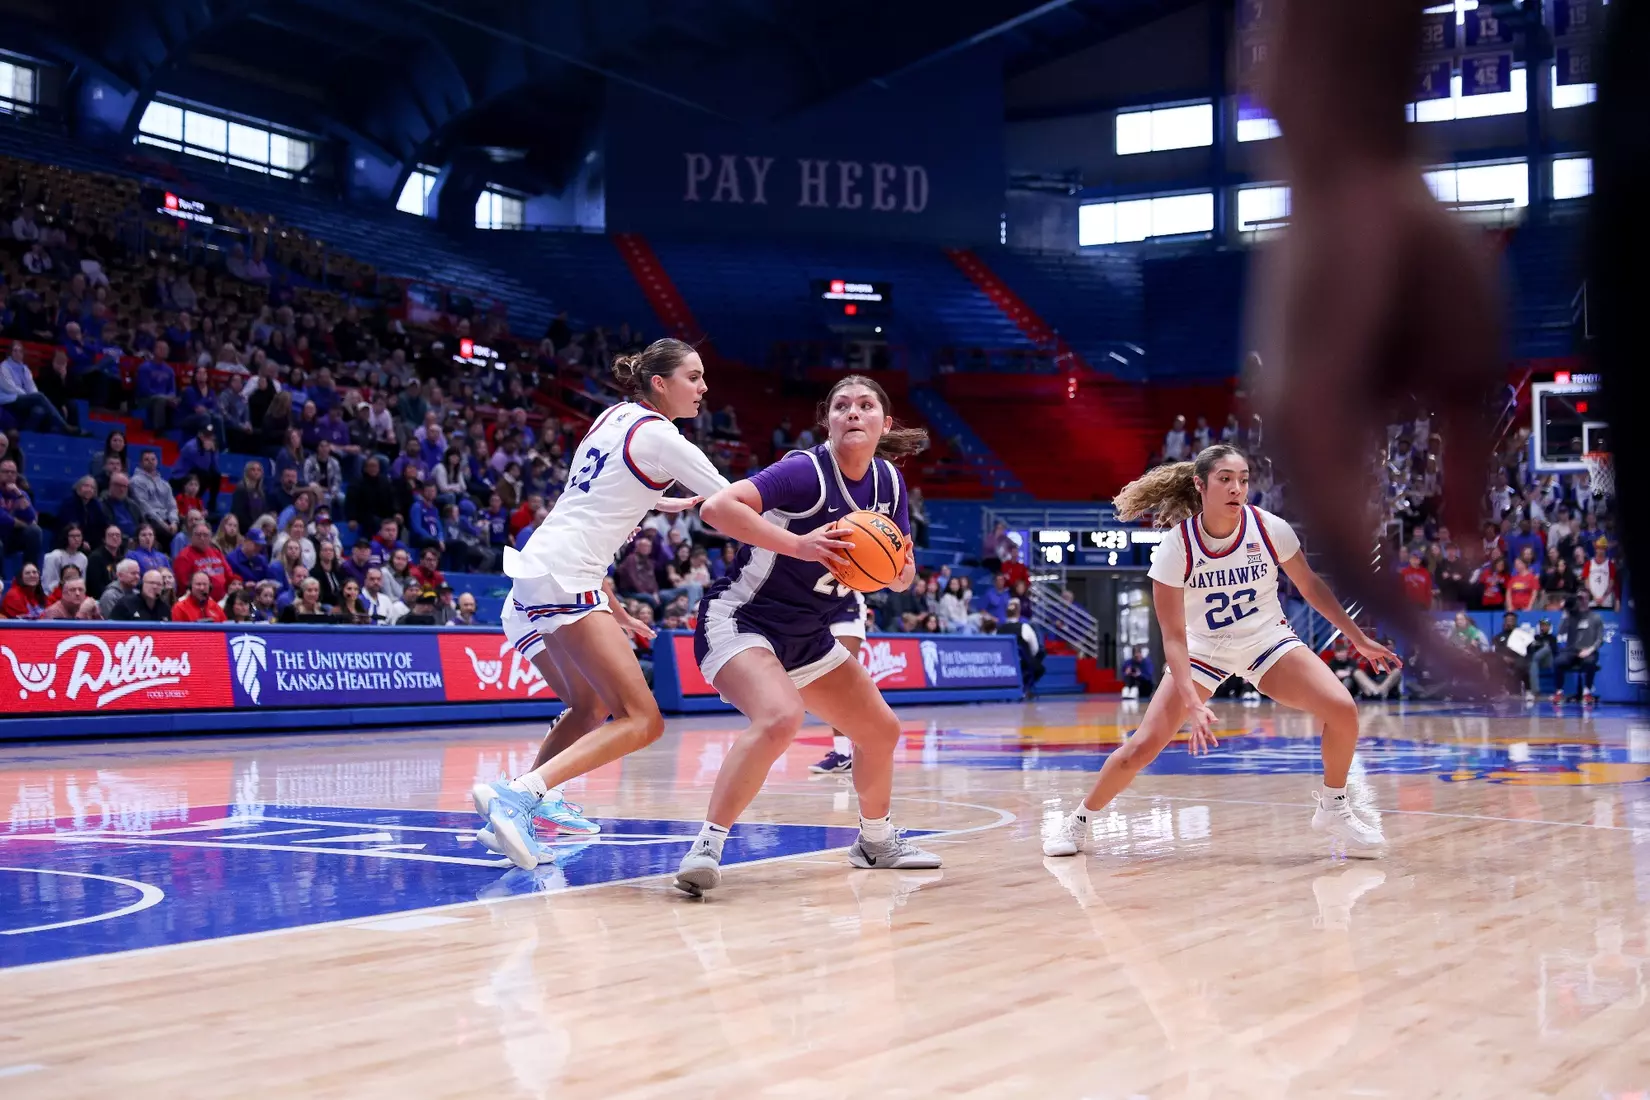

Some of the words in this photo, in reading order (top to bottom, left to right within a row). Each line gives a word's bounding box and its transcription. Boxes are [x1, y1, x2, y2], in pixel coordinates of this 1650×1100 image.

[684, 152, 774, 204] PAY
[797, 158, 929, 213] HEED
[870, 518, 903, 552] NCAA
[1189, 563, 1268, 588] JAYHAWKS
[1205, 588, 1259, 630] 22
[55, 634, 191, 701] Dillons
[272, 650, 306, 670] THE
[307, 649, 393, 670] UNIVERSITY
[394, 652, 413, 669] OF
[275, 671, 334, 692] KANSAS
[337, 670, 391, 691] HEALTH
[393, 669, 443, 689] SYSTEM
